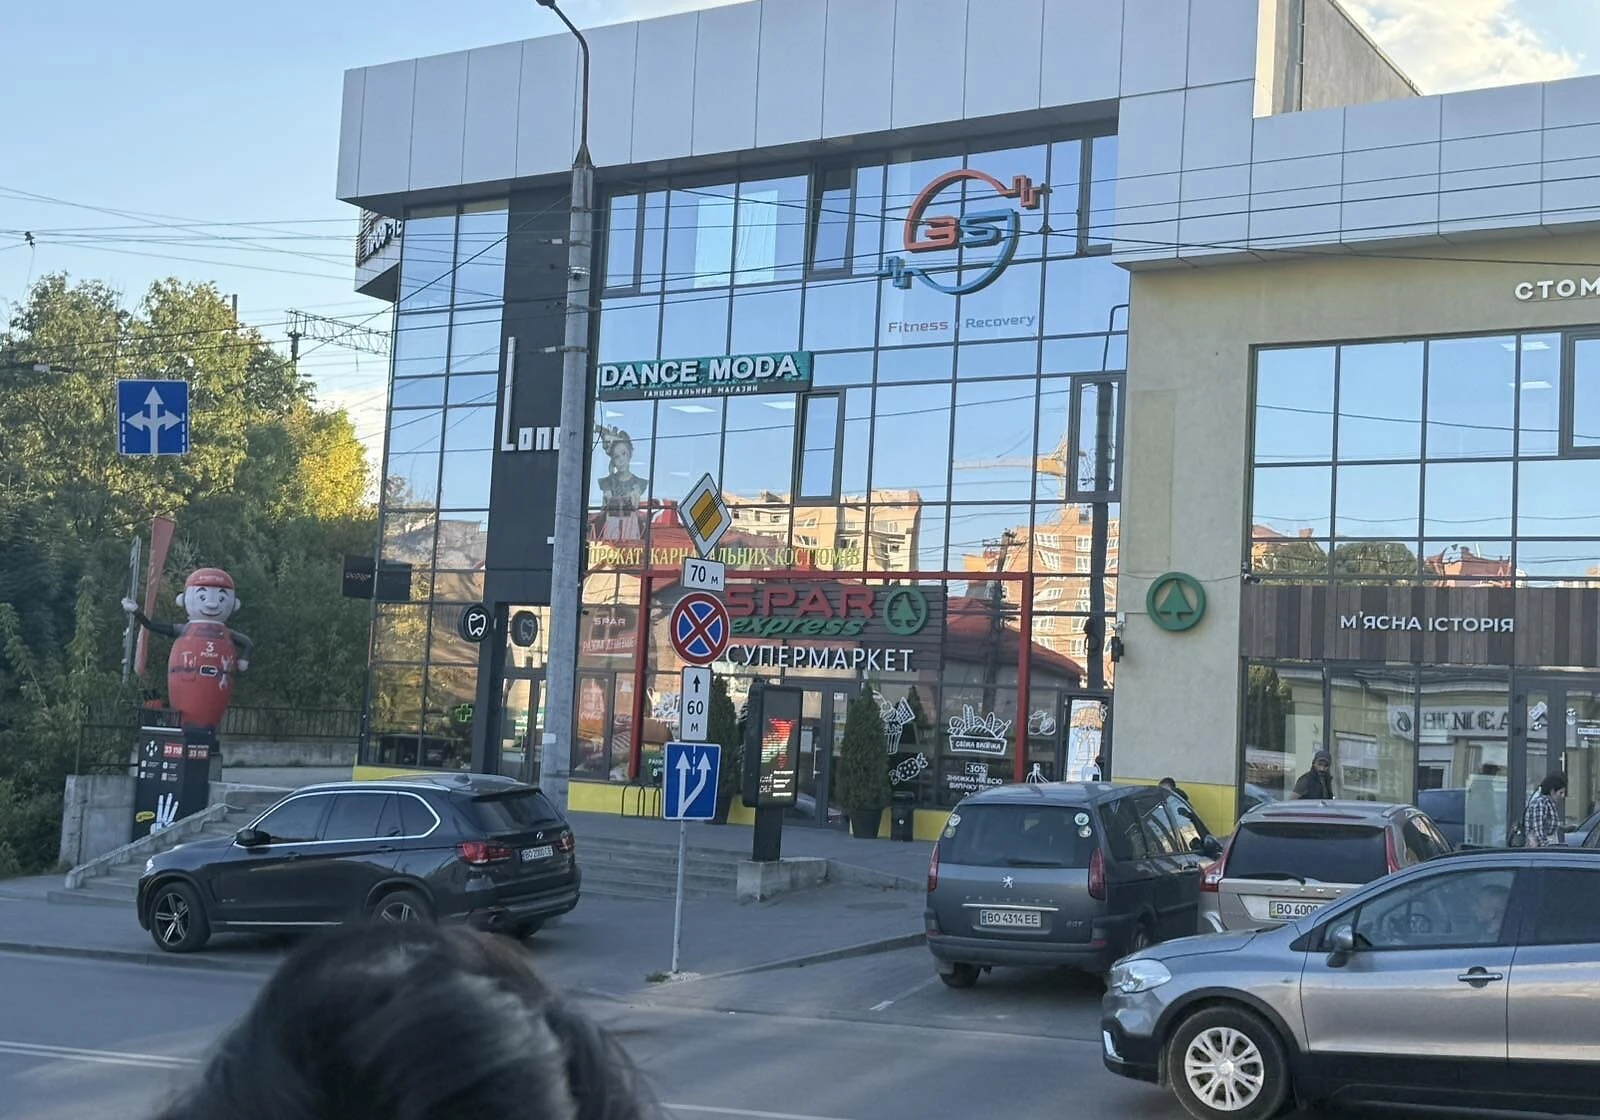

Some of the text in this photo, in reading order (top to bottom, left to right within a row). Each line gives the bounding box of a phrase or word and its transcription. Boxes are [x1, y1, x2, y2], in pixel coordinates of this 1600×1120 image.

[1514, 276, 1600, 300] СТОМ
[888, 315, 1036, 333] Fitness Recovery
[601, 355, 799, 387] DANCE MODA
[718, 384, 758, 394] МАГАЗИН
[587, 546, 643, 566] ПРОКАТ
[650, 546, 769, 566] КАРНААЛЬНИХ
[690, 565, 706, 582] 70
[725, 584, 874, 619] SPAR
[594, 617, 626, 625] SPAR
[729, 615, 867, 637] express
[1340, 611, 1514, 633] М'ЯСНА ІСТОРІЯ
[726, 644, 914, 672] СУПЕРМАРКЕТ
[687, 700, 704, 715] 60
[1276, 903, 1292, 914] BO
[986, 913, 1039, 925] BO 4314 EE
